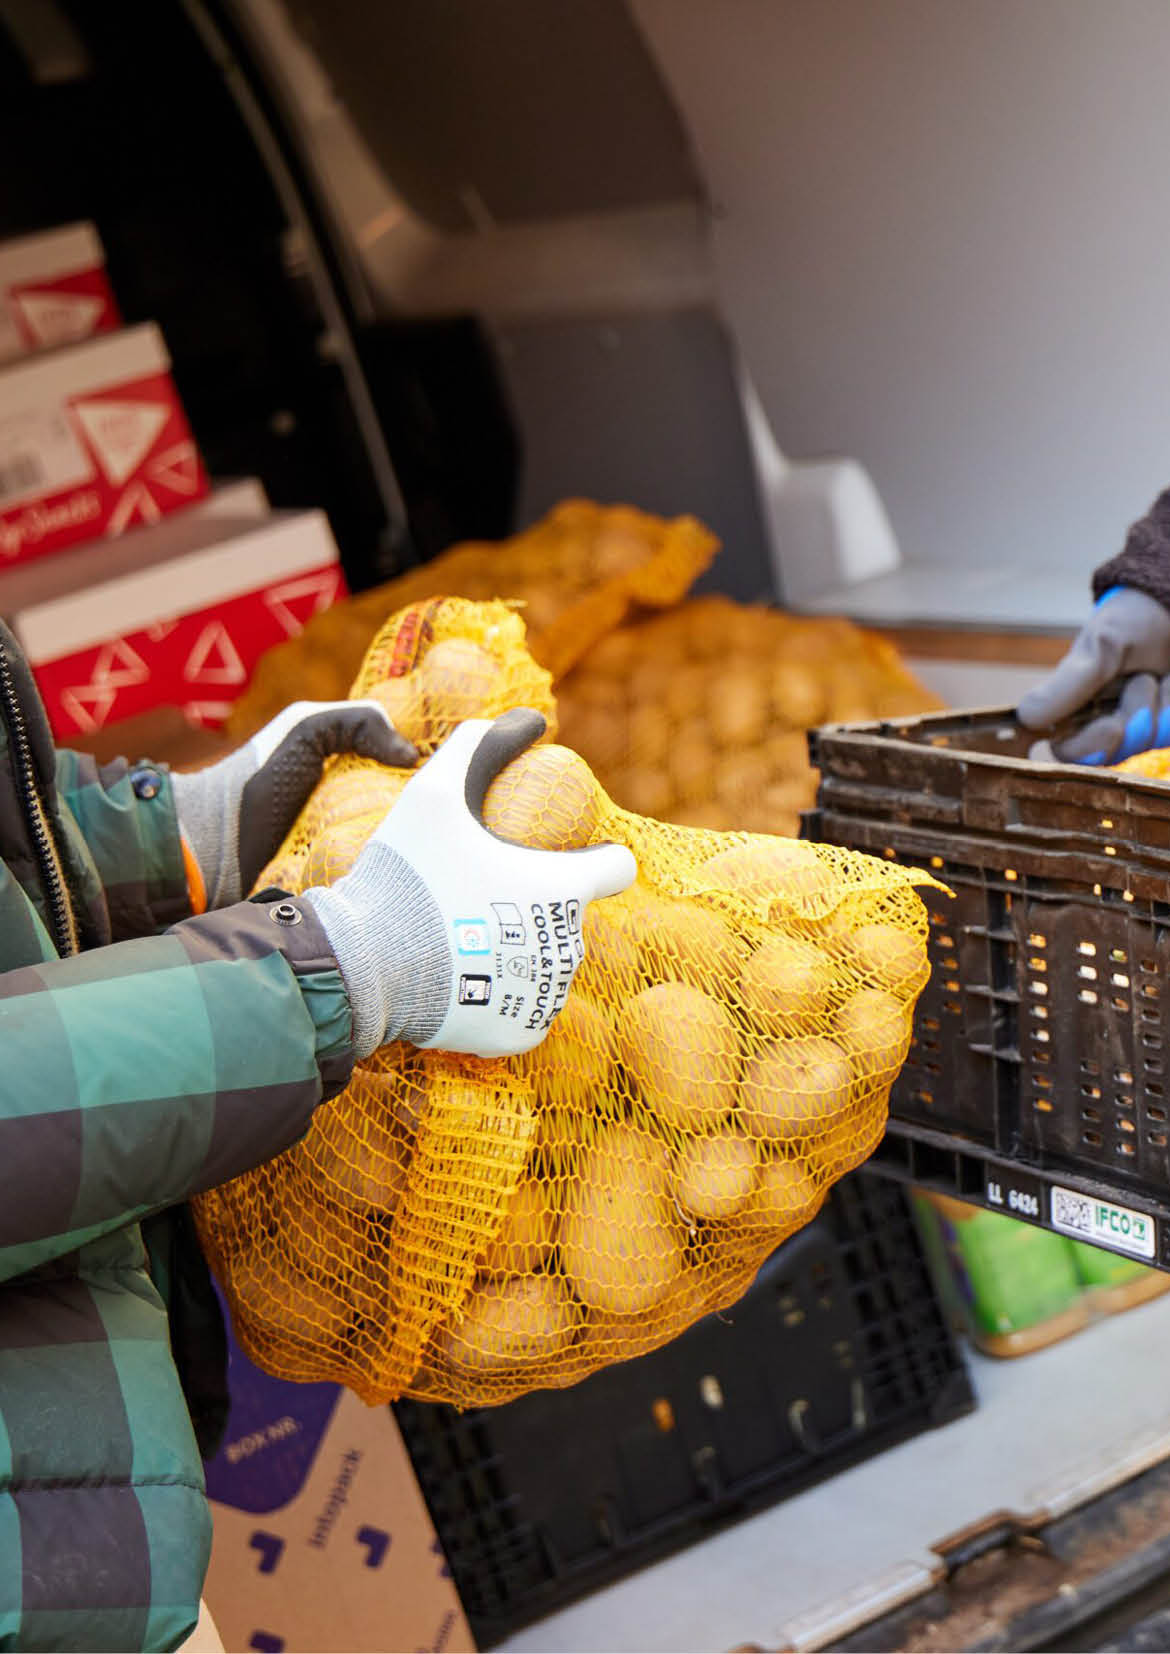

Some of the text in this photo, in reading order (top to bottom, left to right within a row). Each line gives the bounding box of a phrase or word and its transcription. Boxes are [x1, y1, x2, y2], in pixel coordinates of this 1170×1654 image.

[549, 902, 573, 975] MULTI
[988, 1182, 1038, 1216] LL 6424
[1095, 1205, 1131, 1235] IFCO
